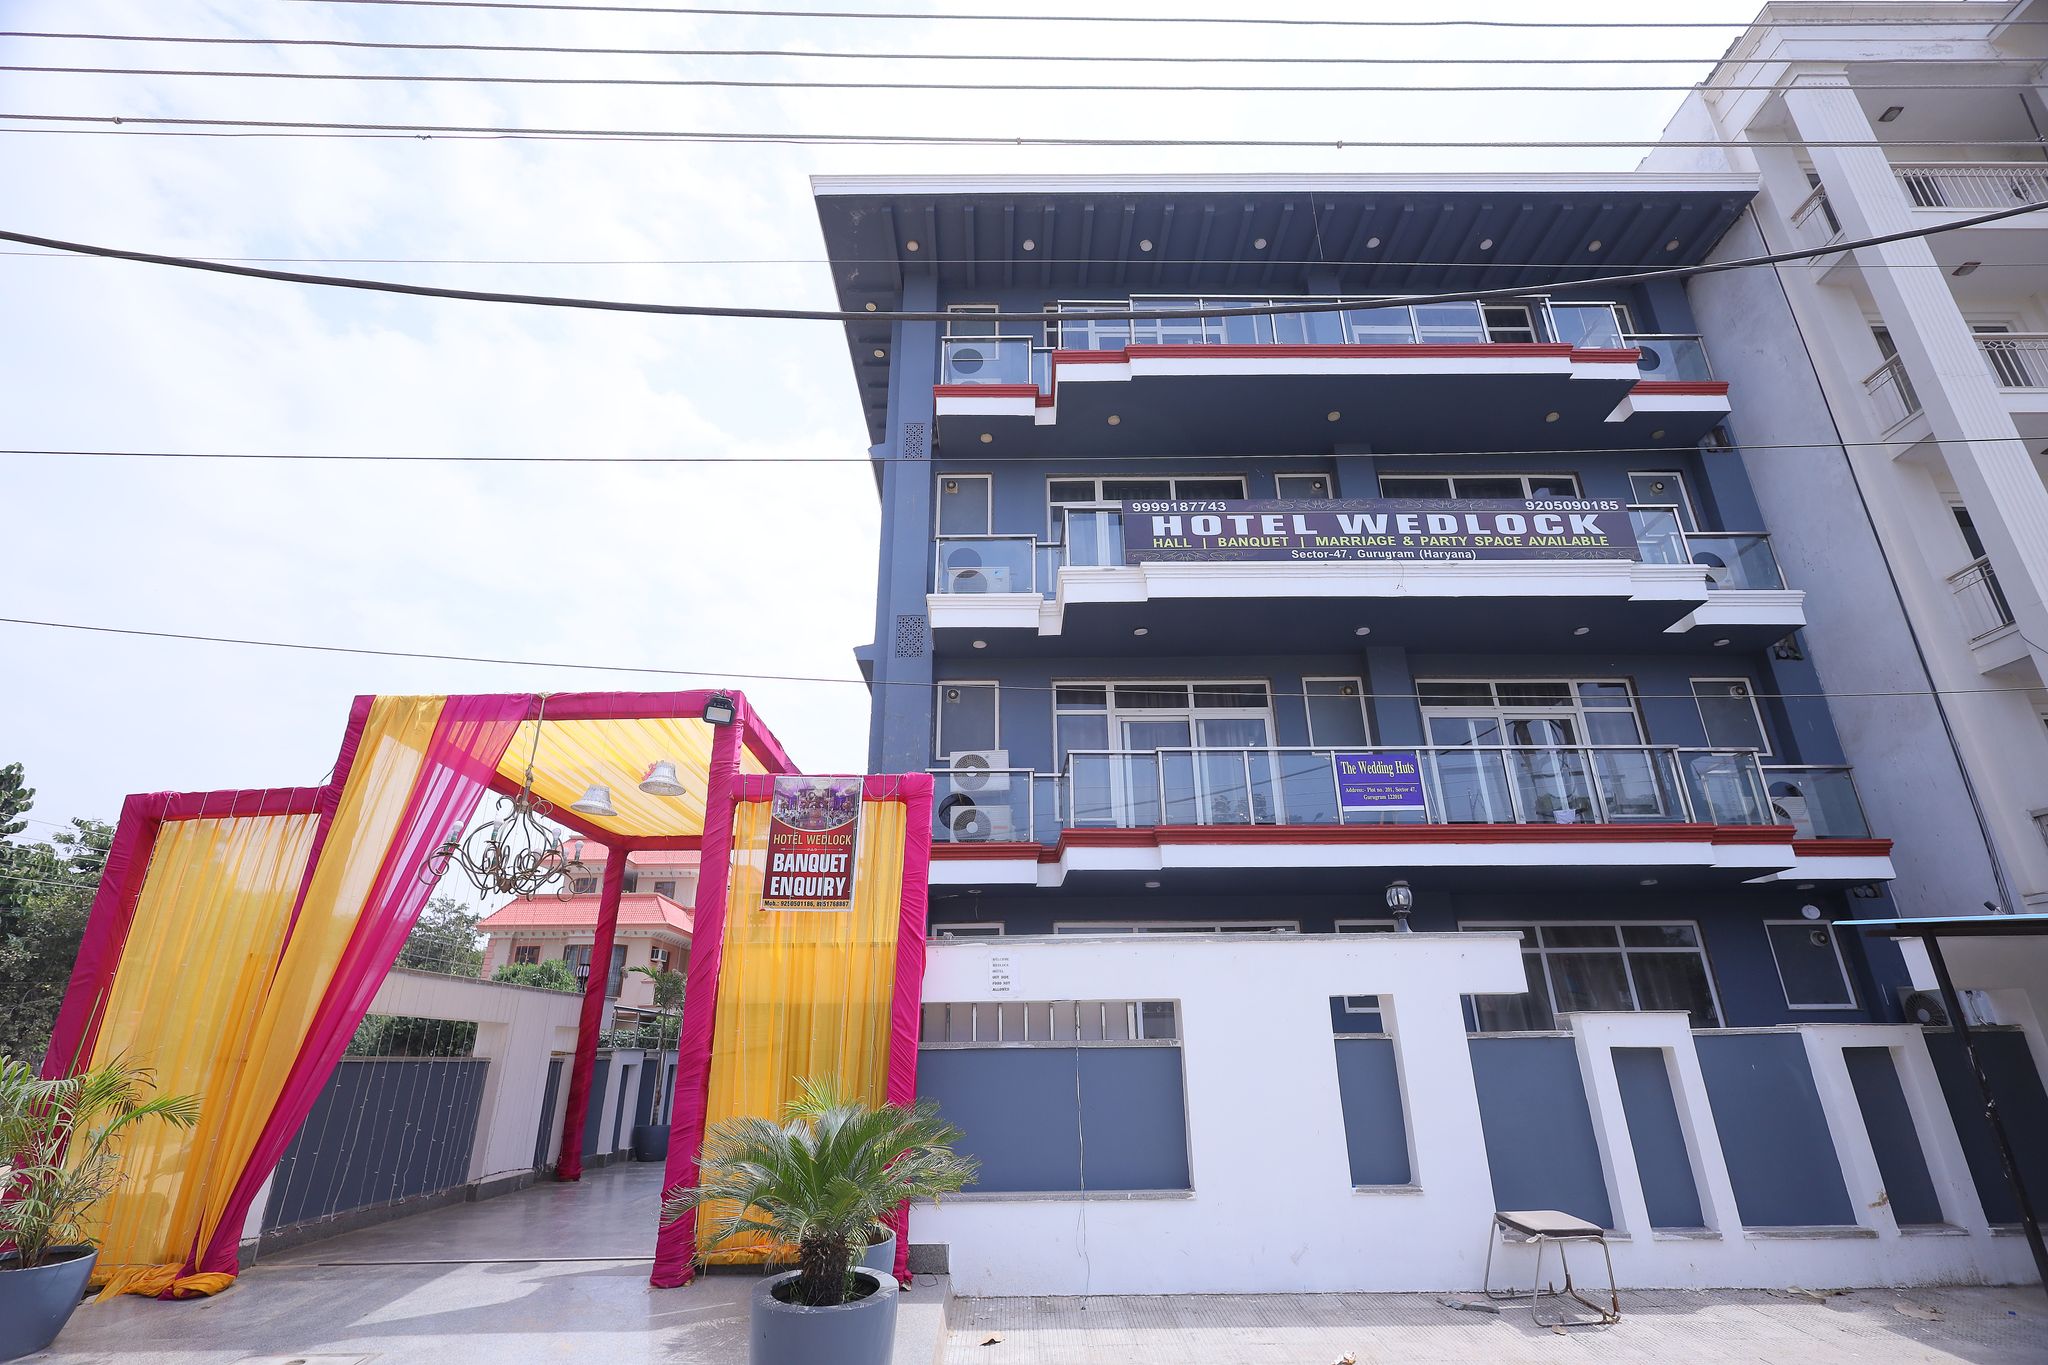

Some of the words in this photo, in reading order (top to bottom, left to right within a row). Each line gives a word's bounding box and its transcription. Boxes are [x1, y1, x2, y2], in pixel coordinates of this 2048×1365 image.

[1132, 502, 1227, 512] 9999187743
[1525, 500, 1619, 511] 9205090185
[1151, 514, 1318, 536] HOTEL
[1336, 514, 1606, 535] WEDLOCK
[1152, 538, 1192, 549] HALL
[1218, 536, 1289, 548] BANQUET
[1315, 536, 1396, 546] MARRIAGE
[1402, 536, 1414, 546] &
[1420, 536, 1468, 546] PARTY
[1474, 536, 1522, 546] SPACE
[1528, 536, 1610, 546] AVAILABLE
[1291, 550, 1352, 560] Sector-47,
[1357, 550, 1415, 560] Gurugram
[1419, 549, 1477, 560] (Haryana)
[1340, 761, 1356, 774] The
[1358, 760, 1394, 778] Wedding
[1395, 760, 1415, 774] Huts
[773, 834, 803, 845] HOTEL
[806, 834, 852, 846] WEDLOCK
[772, 853, 848, 873] BANQUET
[770, 876, 847, 897] ENQUIRY
